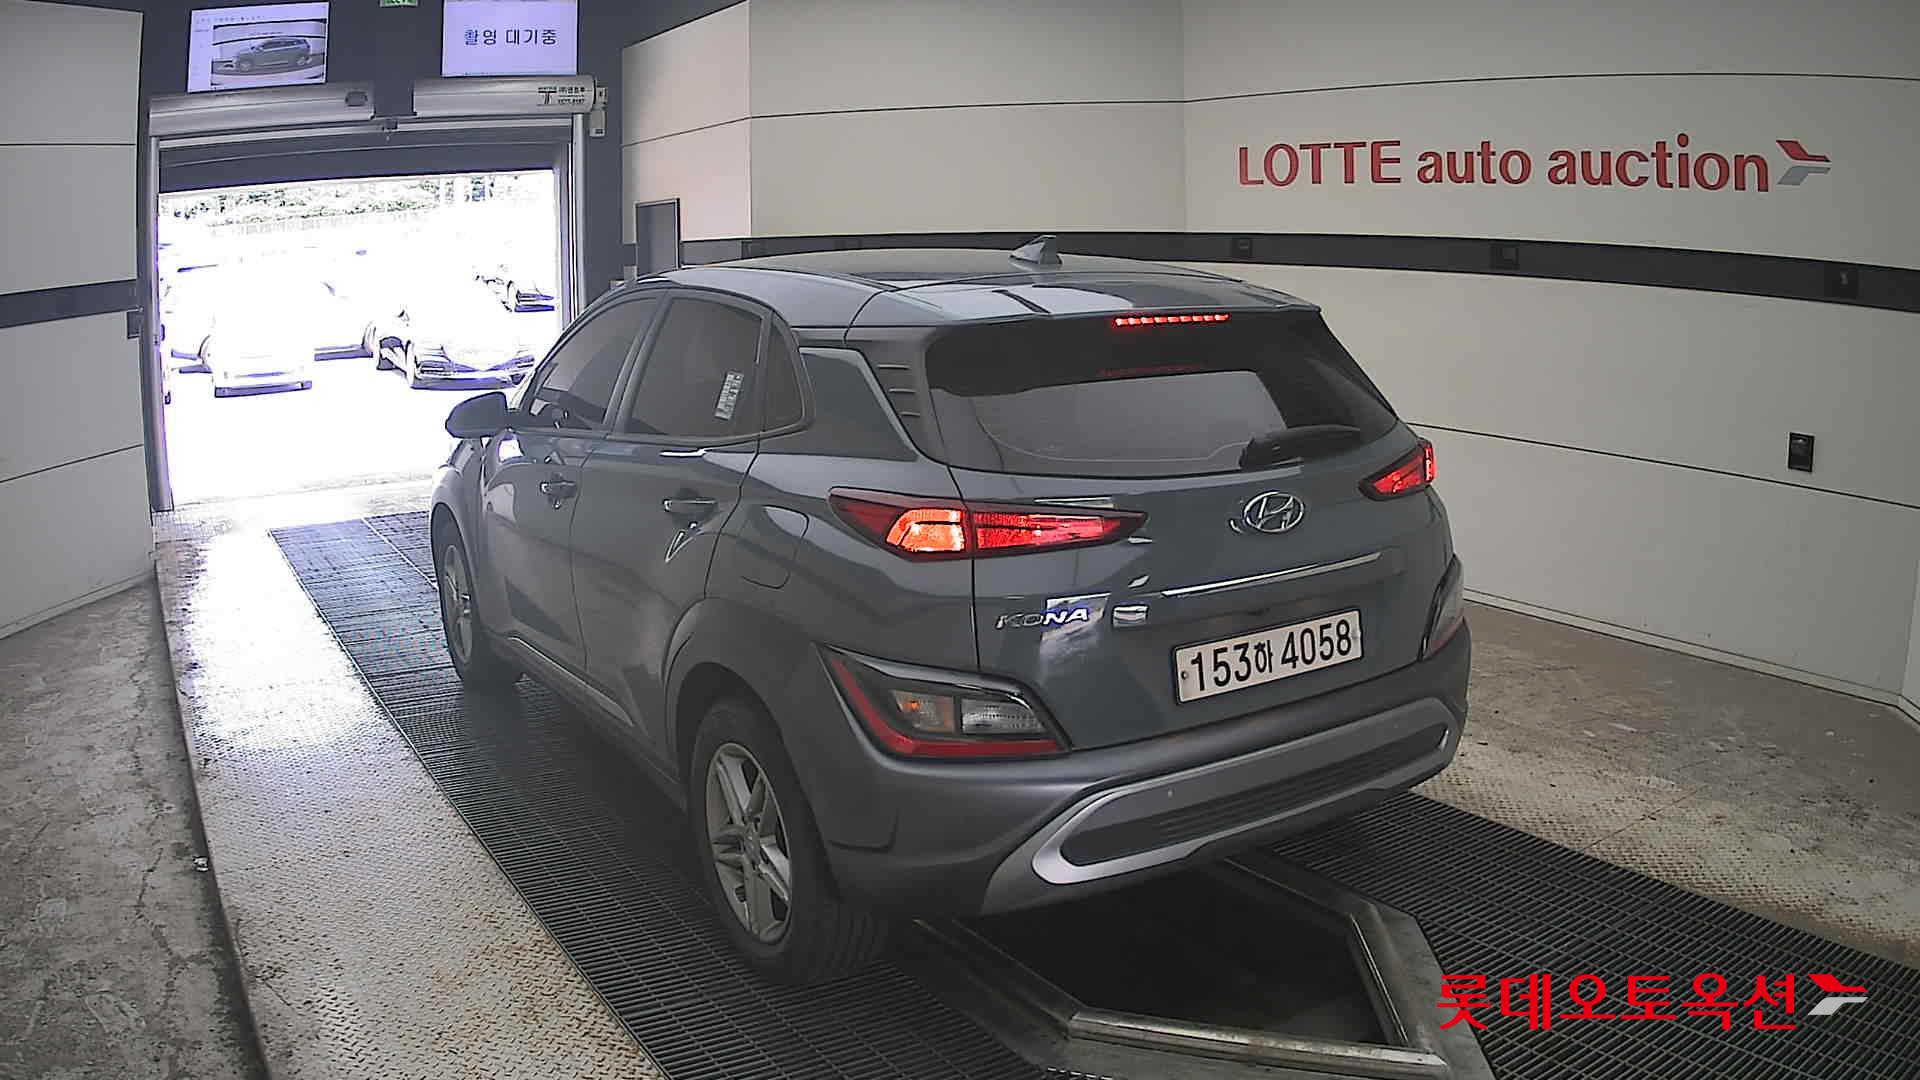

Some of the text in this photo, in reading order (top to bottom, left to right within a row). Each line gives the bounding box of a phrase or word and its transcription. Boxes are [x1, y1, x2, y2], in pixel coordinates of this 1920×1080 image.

[505, 29, 557, 45] 대기중
[1238, 132, 1770, 193] LOTTE auto auction
[996, 607, 1089, 630] KONA
[1190, 619, 1352, 692] 153하 4058
